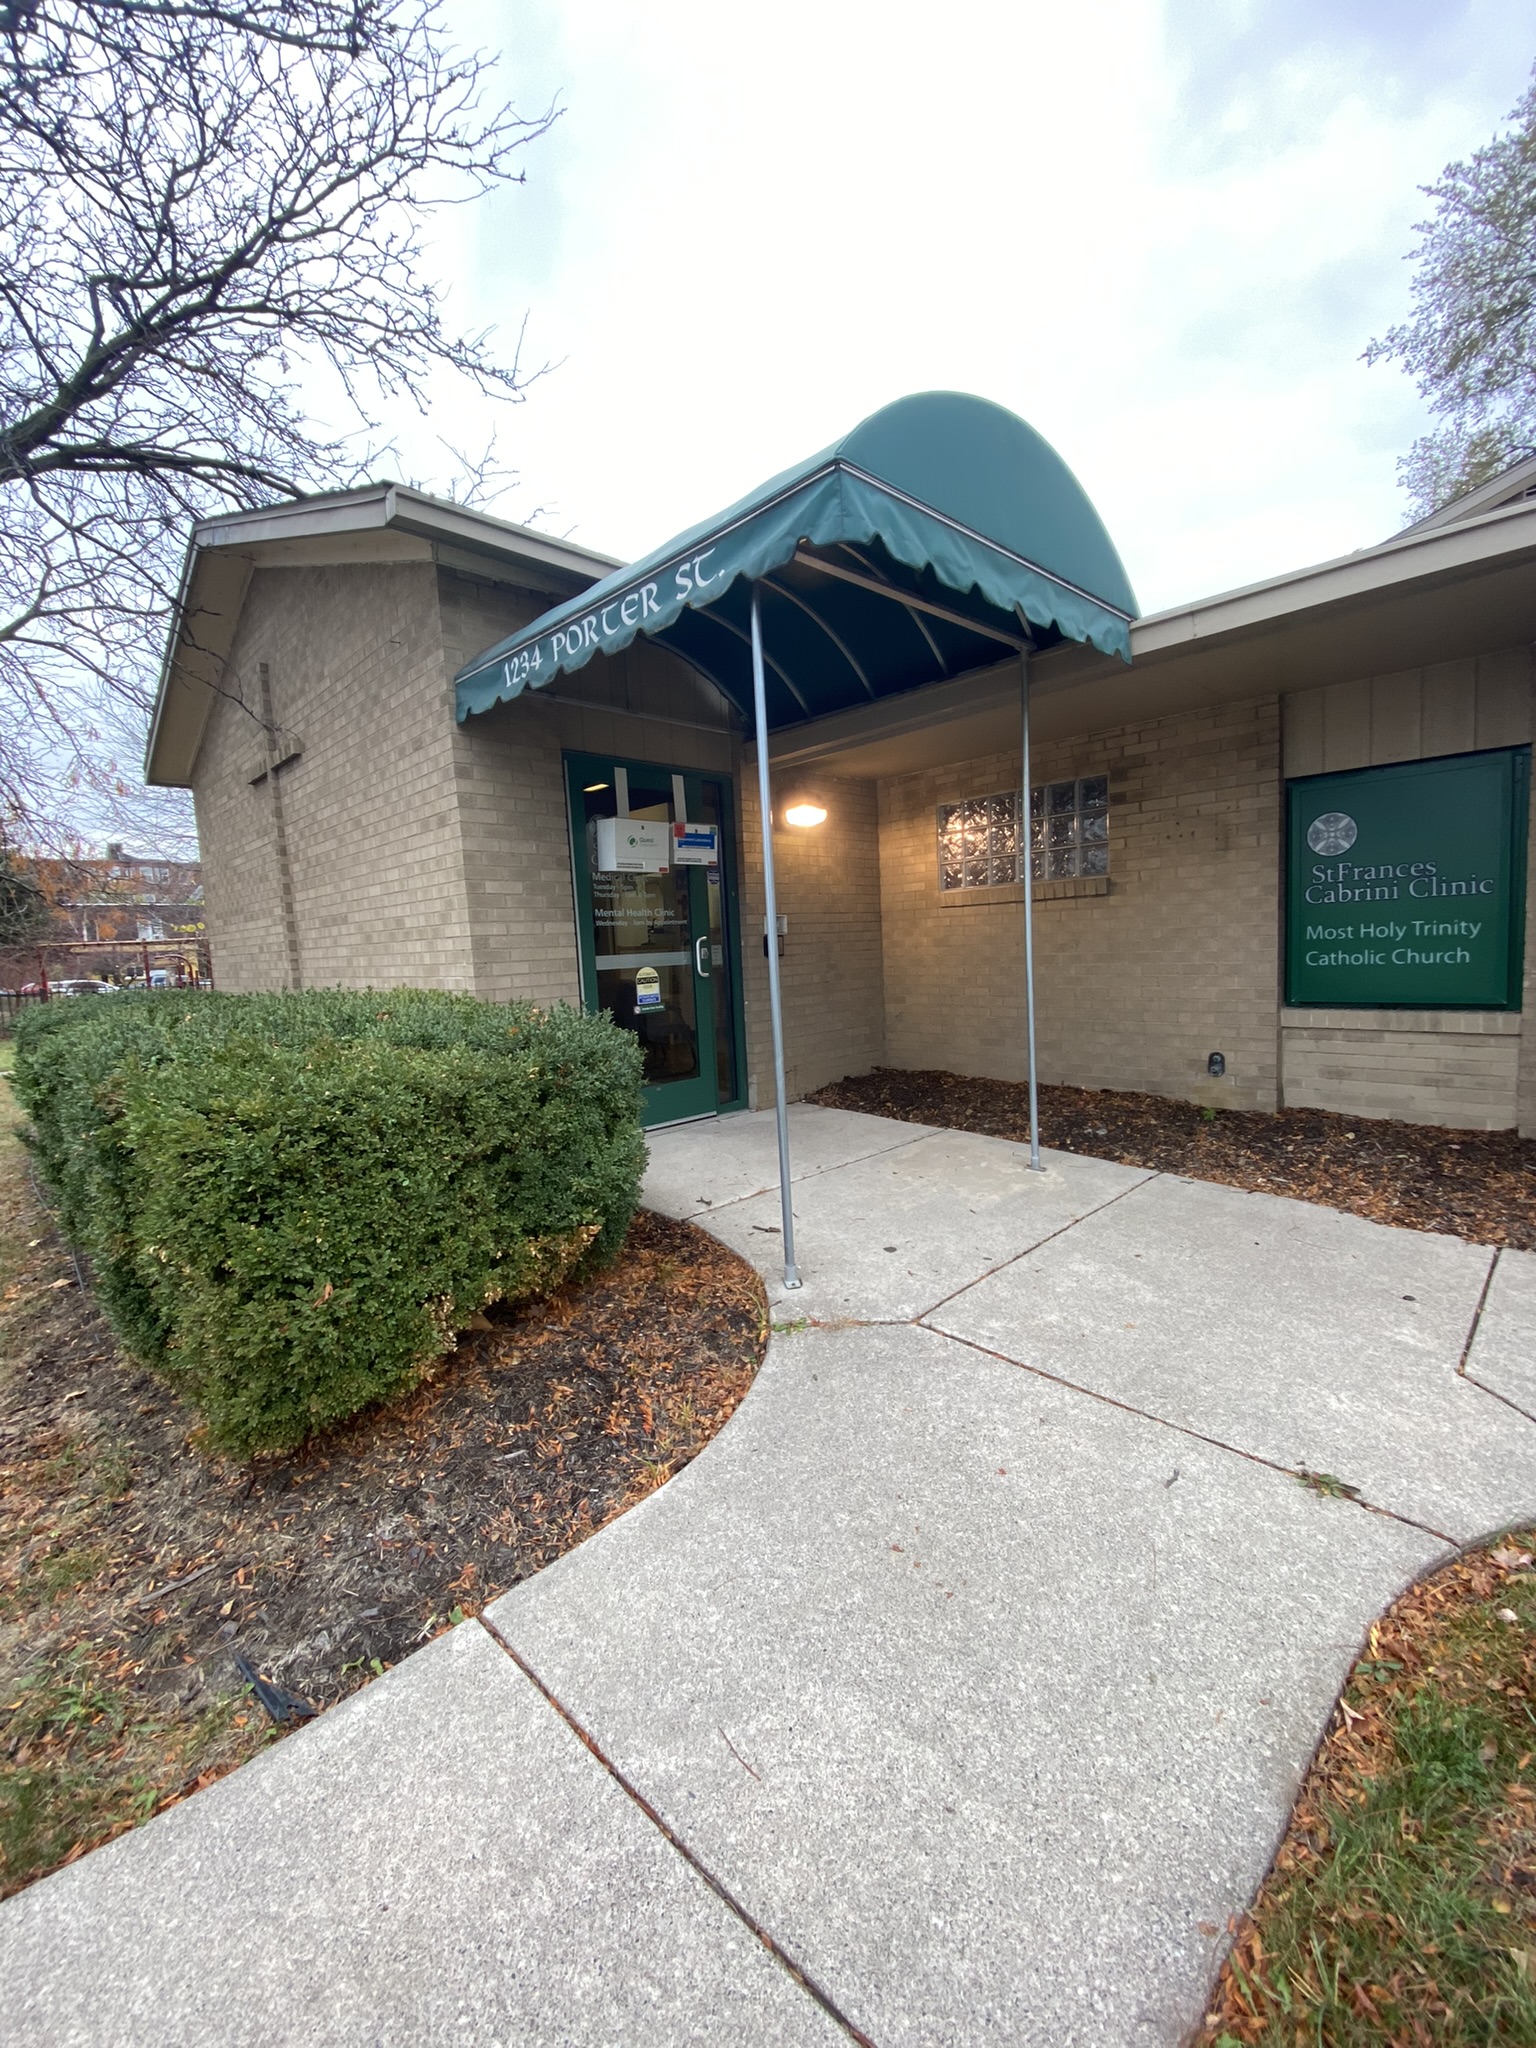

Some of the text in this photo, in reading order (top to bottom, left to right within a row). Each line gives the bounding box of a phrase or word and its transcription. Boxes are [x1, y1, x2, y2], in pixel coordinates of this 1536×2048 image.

[503, 548, 725, 687] 1234 PORTER ST.
[1305, 874, 1494, 904] Cabrini Clinic
[595, 907, 675, 917] Mental Health Clinic
[1306, 919, 1482, 941] Most Holy Trinity
[1305, 947, 1470, 966] Catholic Church
